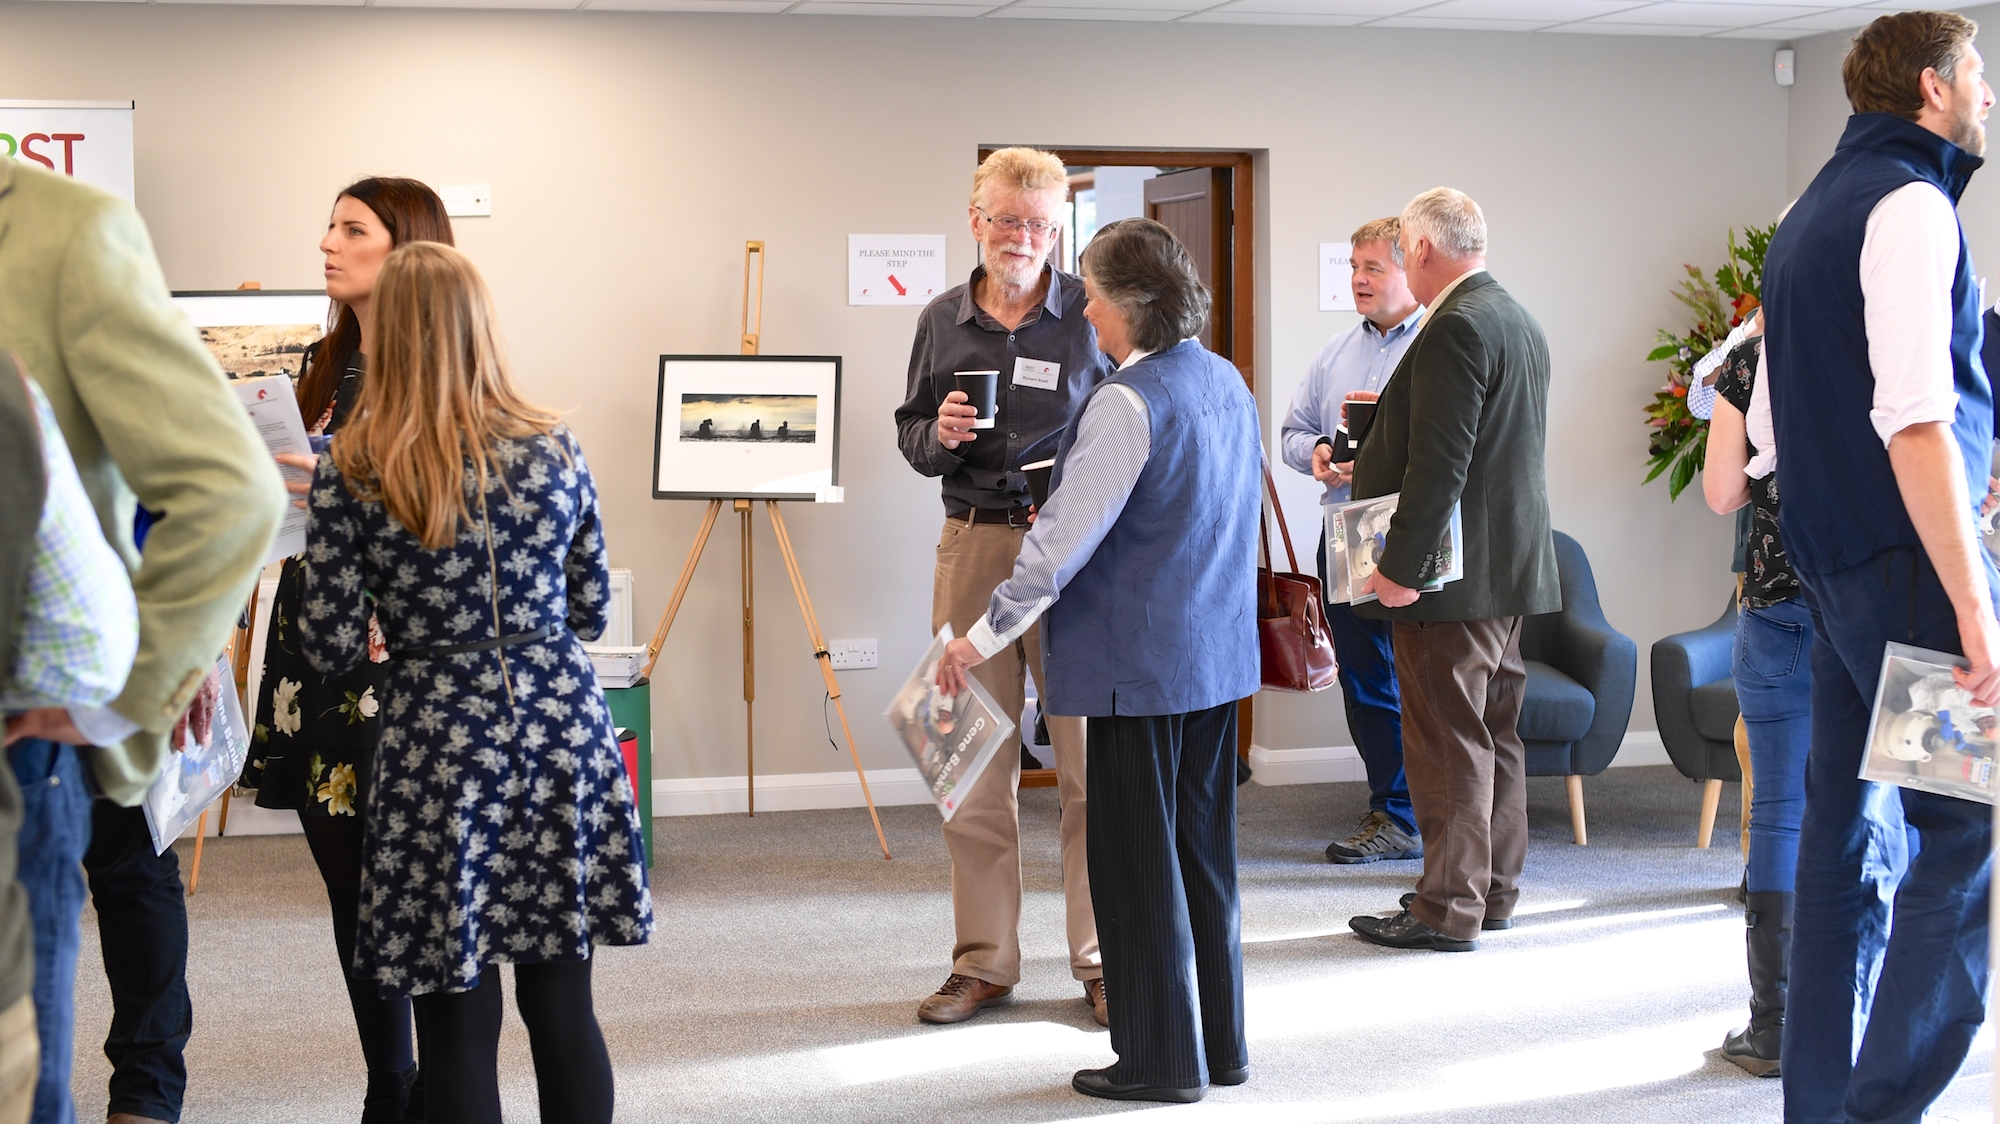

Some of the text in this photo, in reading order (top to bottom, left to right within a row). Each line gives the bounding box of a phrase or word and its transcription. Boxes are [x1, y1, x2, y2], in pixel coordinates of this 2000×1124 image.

[859, 249, 936, 258] PLEASE MIND THE
[886, 260, 908, 268] STEP
[1329, 257, 1351, 265] PLEA
[1335, 518, 1344, 540] RBST
[1434, 550, 1444, 574] nks
[1443, 549, 1452, 571] RBST
[957, 717, 985, 752] Gene
[224, 726, 240, 774] Banks
[932, 752, 961, 794] Banks
